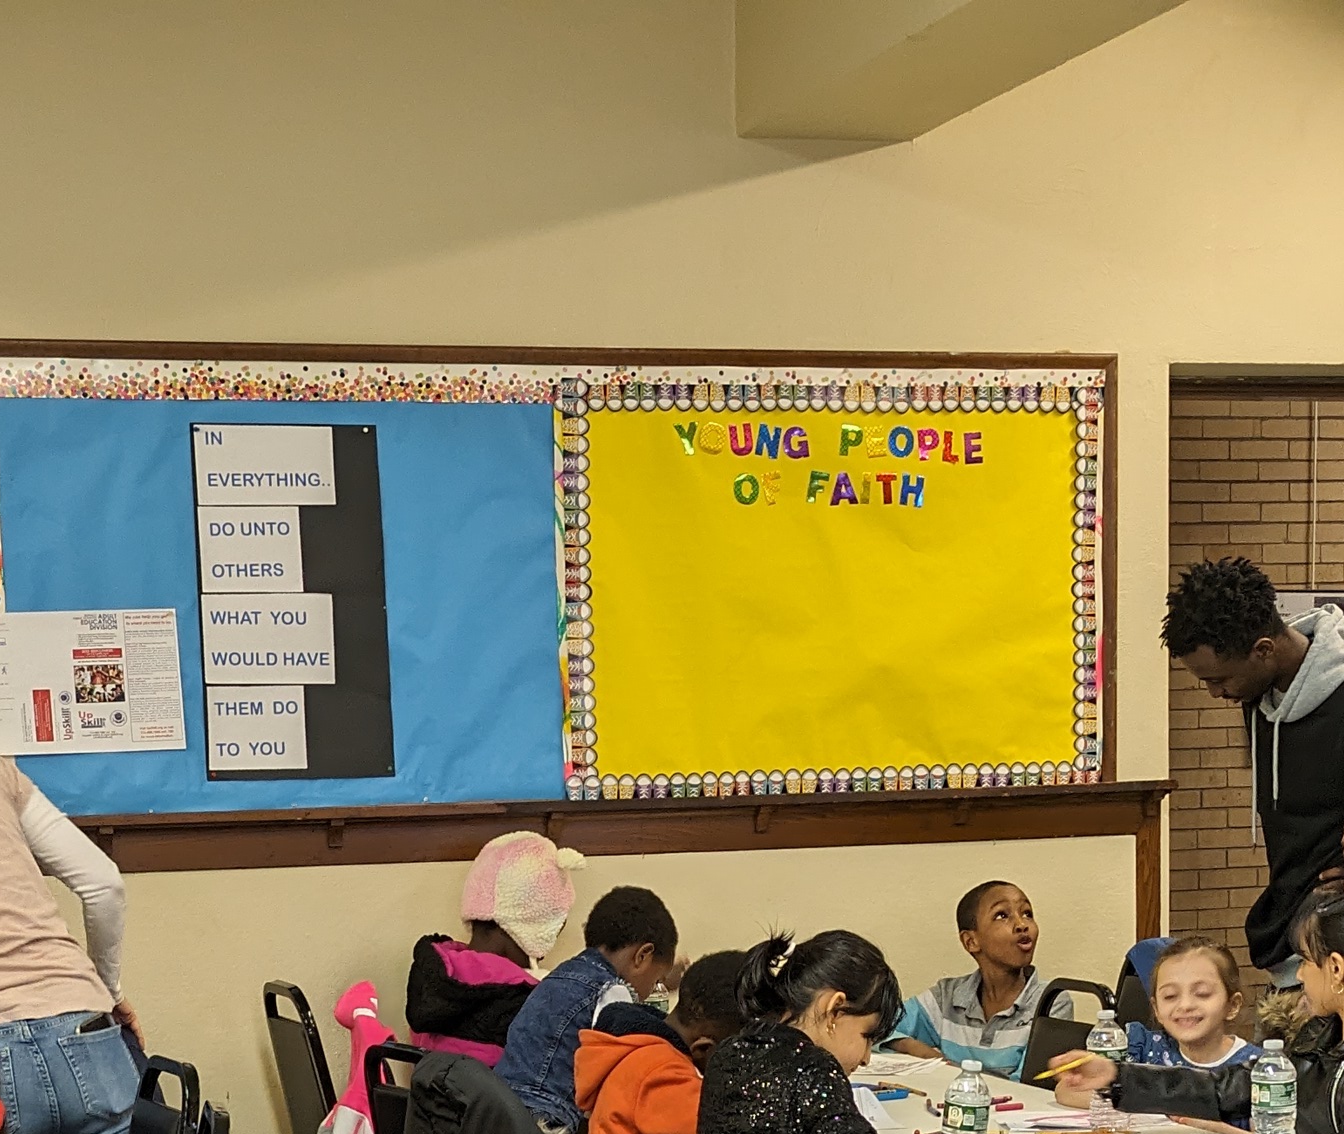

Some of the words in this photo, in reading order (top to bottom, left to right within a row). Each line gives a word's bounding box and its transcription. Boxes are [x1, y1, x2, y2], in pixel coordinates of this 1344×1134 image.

[204, 432, 222, 446] IN
[673, 421, 810, 460] YOUNG
[839, 422, 983, 465] PEOPLE
[207, 473, 331, 487] EVERYTHING..
[733, 471, 781, 506] OF
[806, 471, 925, 507] FAITH
[209, 523, 235, 536] DO
[240, 522, 290, 536] UNTO
[212, 563, 284, 577] OTHERS
[210, 611, 261, 626] WHAT
[270, 611, 307, 625] YOU
[212, 652, 278, 666] WOULD
[283, 652, 330, 666] HAVE
[79, 711, 93, 719] Up
[214, 701, 263, 715] THEM
[273, 701, 299, 715] DO
[81, 718, 102, 726] Skill
[216, 743, 240, 757] TO
[249, 742, 285, 756] YOU
